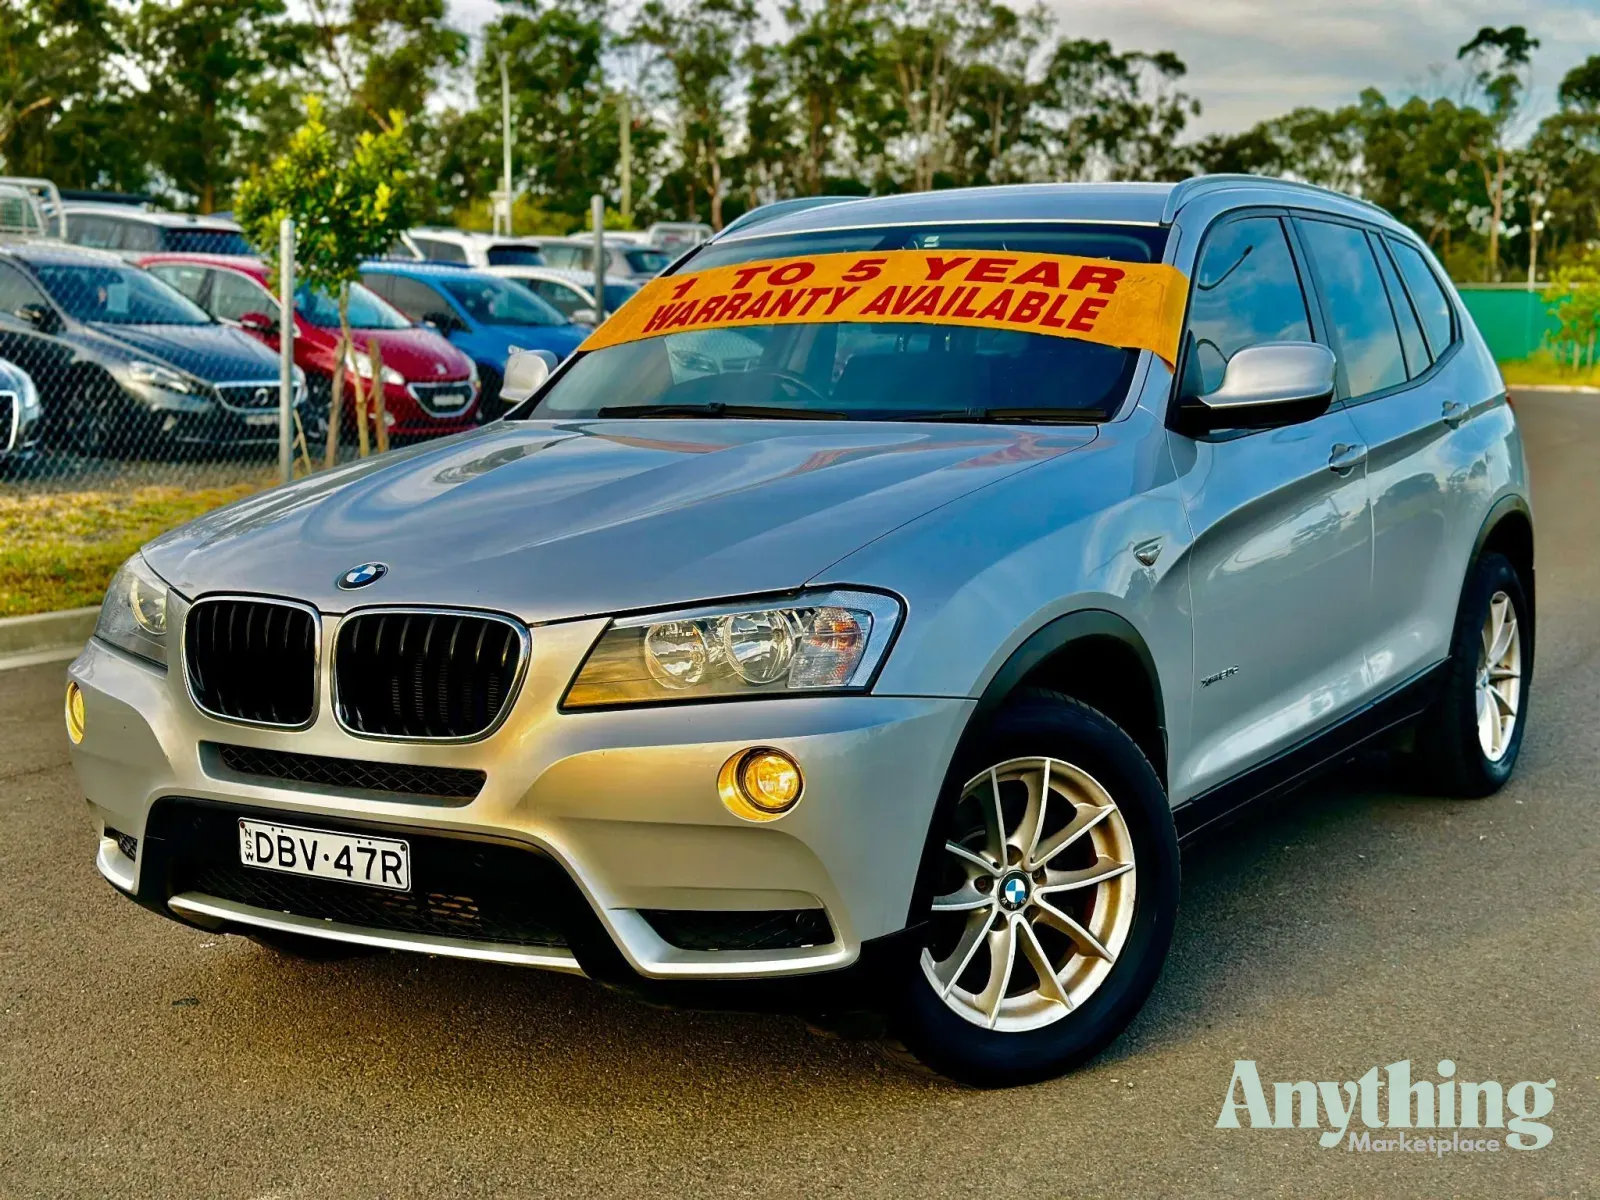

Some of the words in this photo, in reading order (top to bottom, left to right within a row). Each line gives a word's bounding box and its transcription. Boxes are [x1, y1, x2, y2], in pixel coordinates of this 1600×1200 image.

[672, 277, 697, 301] 1
[731, 261, 815, 290] TO
[842, 258, 888, 283] 5
[926, 257, 1126, 295] YEAR
[642, 286, 862, 334] WARRANTY
[860, 285, 1109, 333] AVAILABLE
